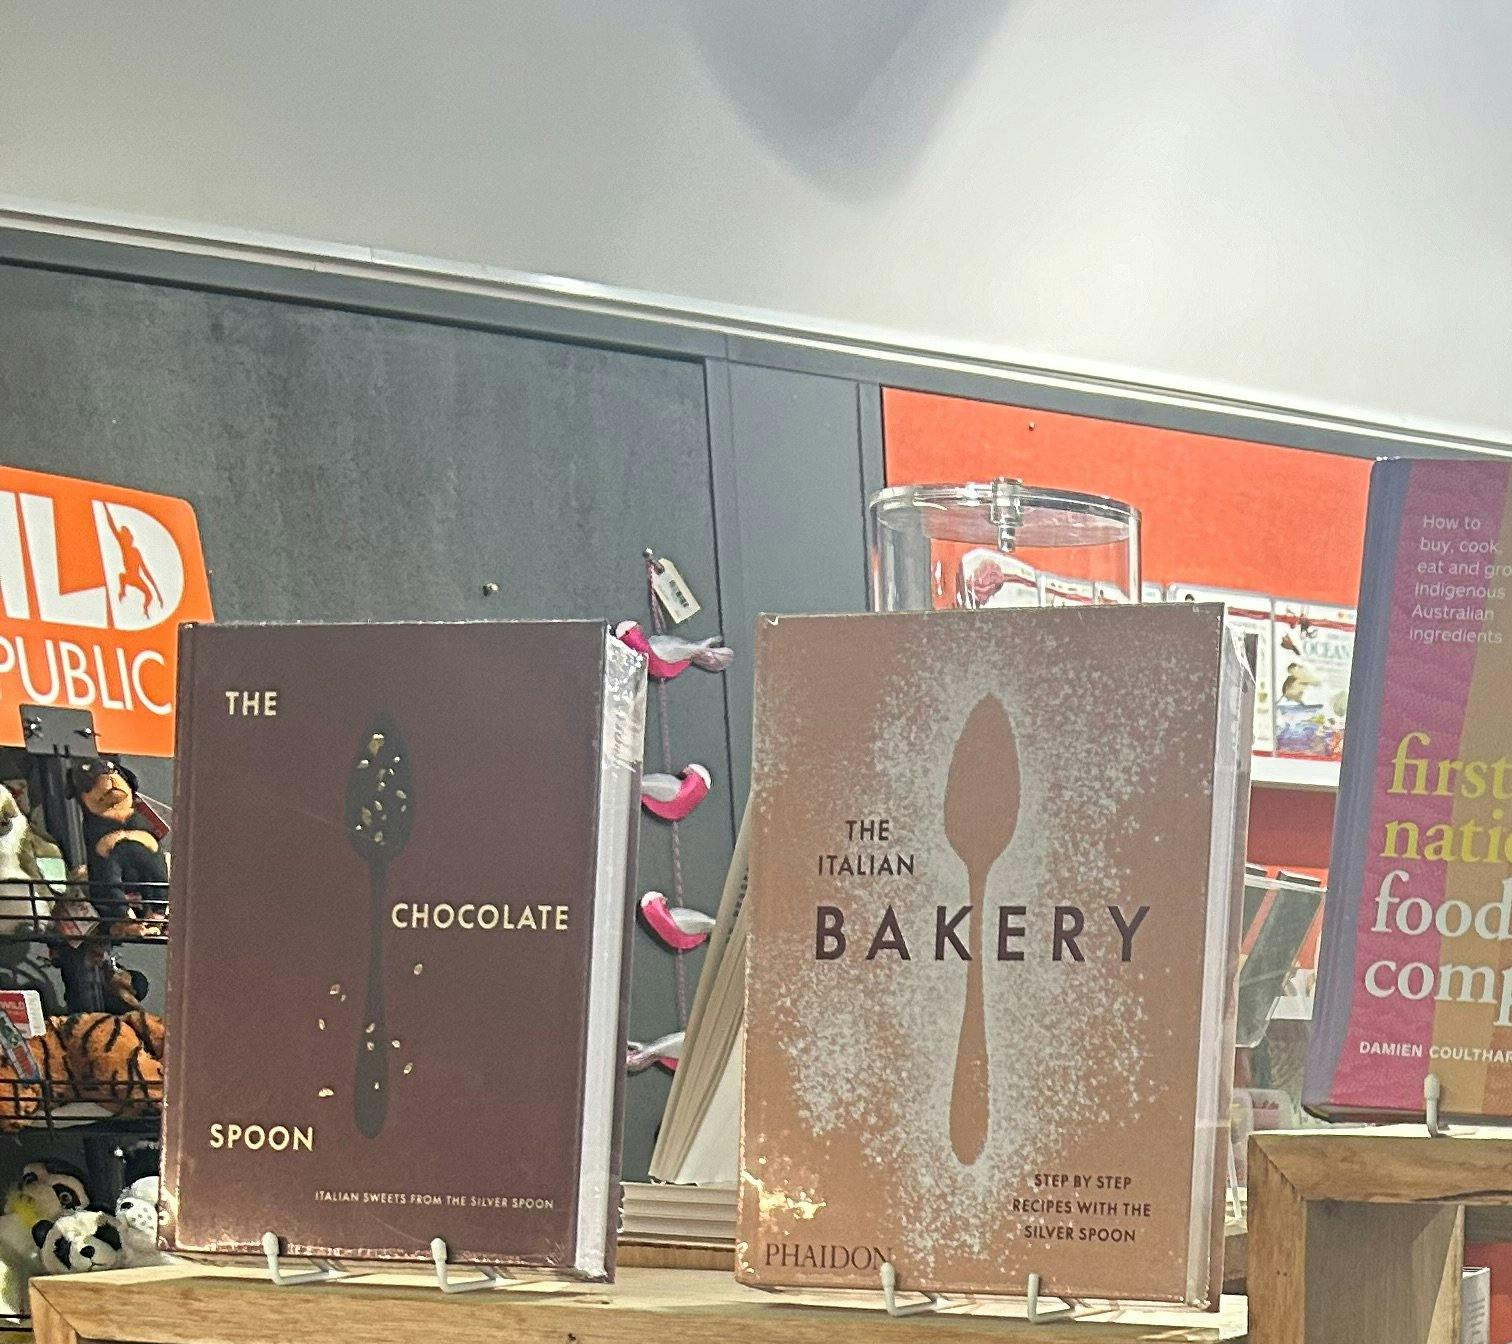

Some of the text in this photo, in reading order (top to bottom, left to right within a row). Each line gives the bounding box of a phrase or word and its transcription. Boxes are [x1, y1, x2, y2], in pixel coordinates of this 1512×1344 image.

[1423, 515, 1481, 530] How to
[1420, 537, 1454, 555] buy,
[1417, 561, 1444, 574] eat
[1449, 561, 1479, 575] and
[1415, 582, 1505, 600] Indigenous
[1412, 604, 1494, 621] Australian
[225, 691, 277, 716] THE
[845, 820, 889, 842] THE
[818, 855, 914, 876] ITALIAN
[391, 903, 569, 930] CHOCOLATE
[814, 905, 1151, 961] BAKERY
[1359, 1041, 1423, 1058] DAMIEN
[210, 1124, 314, 1151] SPOON
[1034, 1174, 1132, 1190] STEP BY STEP
[315, 1190, 554, 1209] ITALIAN SWEETS FROM THE SILVER SPOON
[1012, 1199, 1152, 1217] RECIPES WITH THE
[1023, 1226, 1136, 1243] SILVER SPOON
[764, 1244, 893, 1271] PHAIDON
